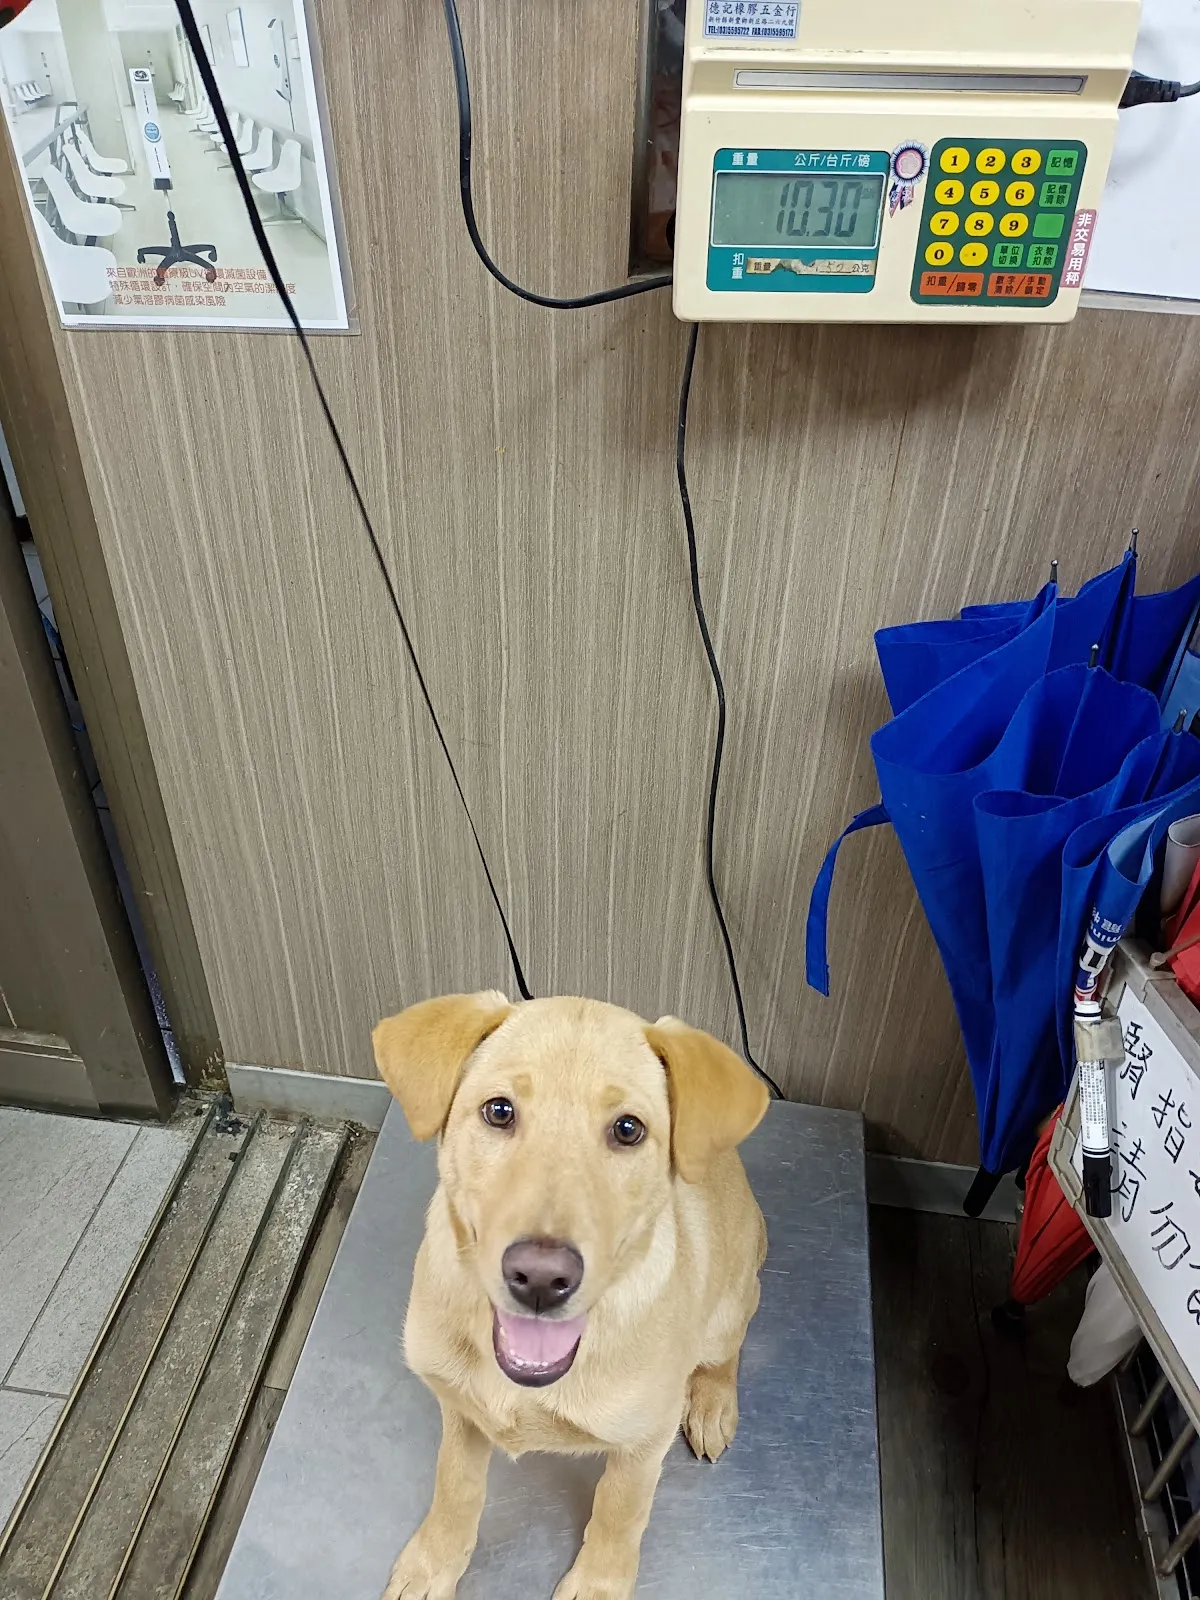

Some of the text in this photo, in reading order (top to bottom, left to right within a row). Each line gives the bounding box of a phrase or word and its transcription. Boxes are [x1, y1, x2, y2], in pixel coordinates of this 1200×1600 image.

[732, 152, 870, 168] 重量 公斤/台斤/磅
[951, 155, 1031, 168] 1 2 3
[1050, 157, 1074, 169] 記憶
[944, 187, 1025, 200] 4 5 6
[776, 180, 863, 237] 10.30
[939, 219, 1019, 231] 7 8 9
[933, 249, 944, 260] 0
[1034, 246, 1055, 256] 衣物
[1064, 212, 1093, 285] 非交易用秤
[731, 253, 744, 279] 扣重
